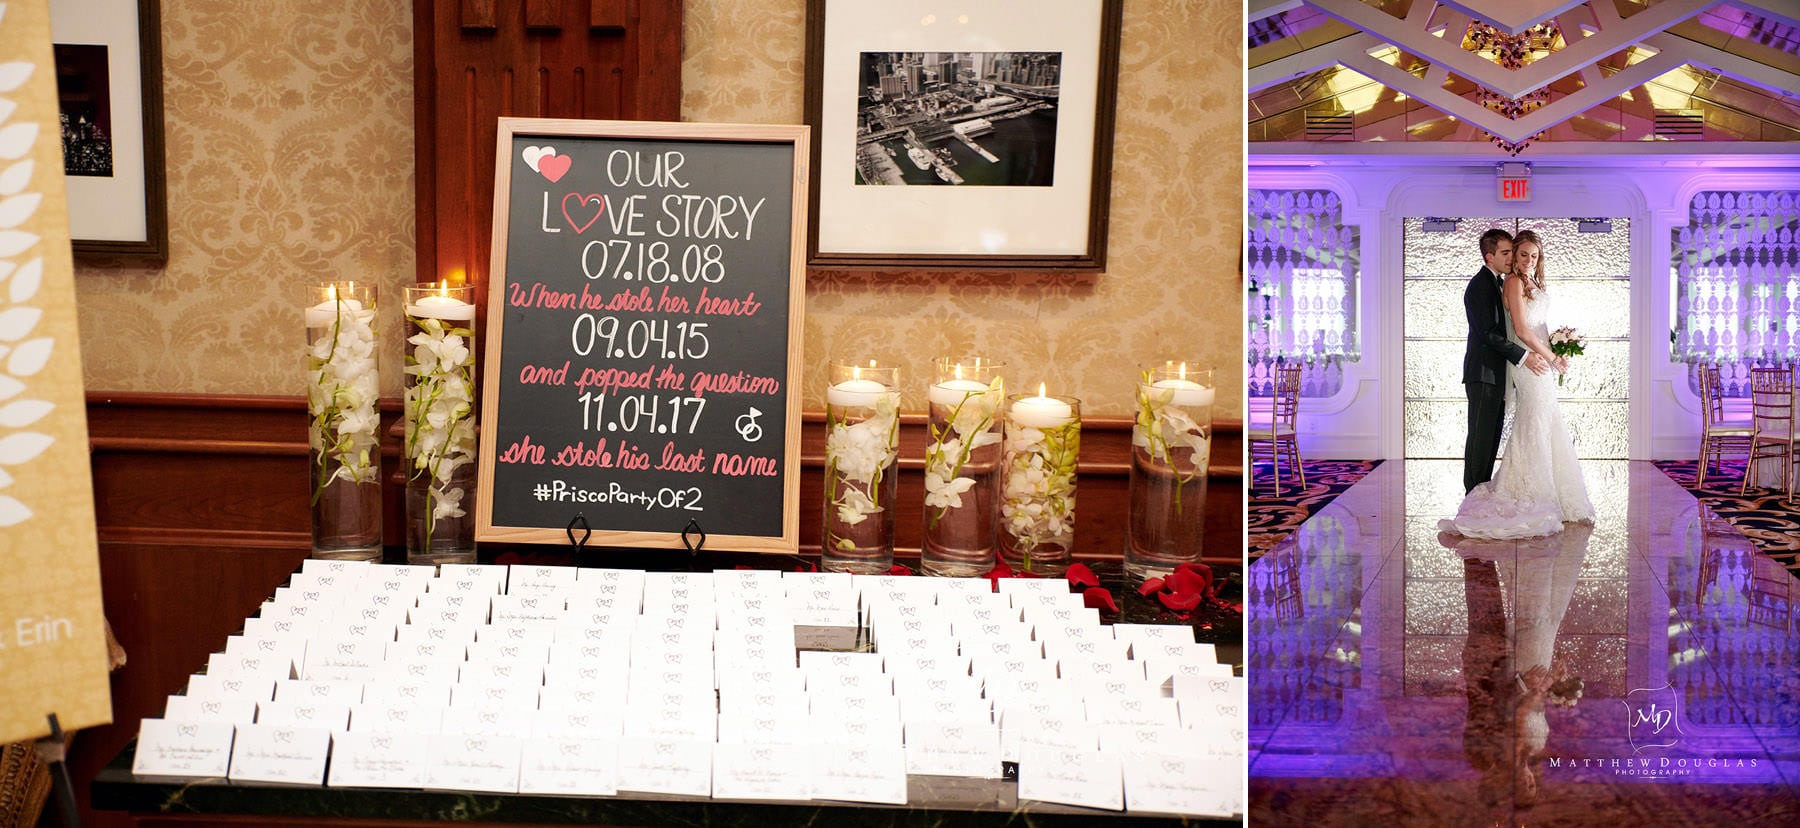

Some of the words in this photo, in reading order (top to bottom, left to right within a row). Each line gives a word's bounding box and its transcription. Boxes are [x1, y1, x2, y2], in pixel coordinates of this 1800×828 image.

[607, 150, 690, 188] OUR
[1503, 179, 1527, 199] EXIT
[656, 195, 766, 240] STORY
[581, 240, 725, 283] 07.18.08
[510, 282, 576, 309] When
[579, 283, 604, 309] he
[605, 286, 654, 313] stole
[657, 285, 690, 314] her
[695, 287, 762, 317] heart
[572, 313, 709, 359] 09.04.15
[520, 361, 571, 387] and
[574, 364, 655, 396] popped
[655, 364, 684, 391] the
[690, 370, 780, 398] question
[578, 392, 706, 434] 11.04.17
[499, 435, 545, 464] she
[552, 438, 613, 468] stole
[615, 440, 650, 470] his
[654, 441, 706, 473] last
[712, 452, 777, 477] name
[533, 479, 704, 511] #PriscoPartyOf2
[15, 615, 73, 647] Erin
